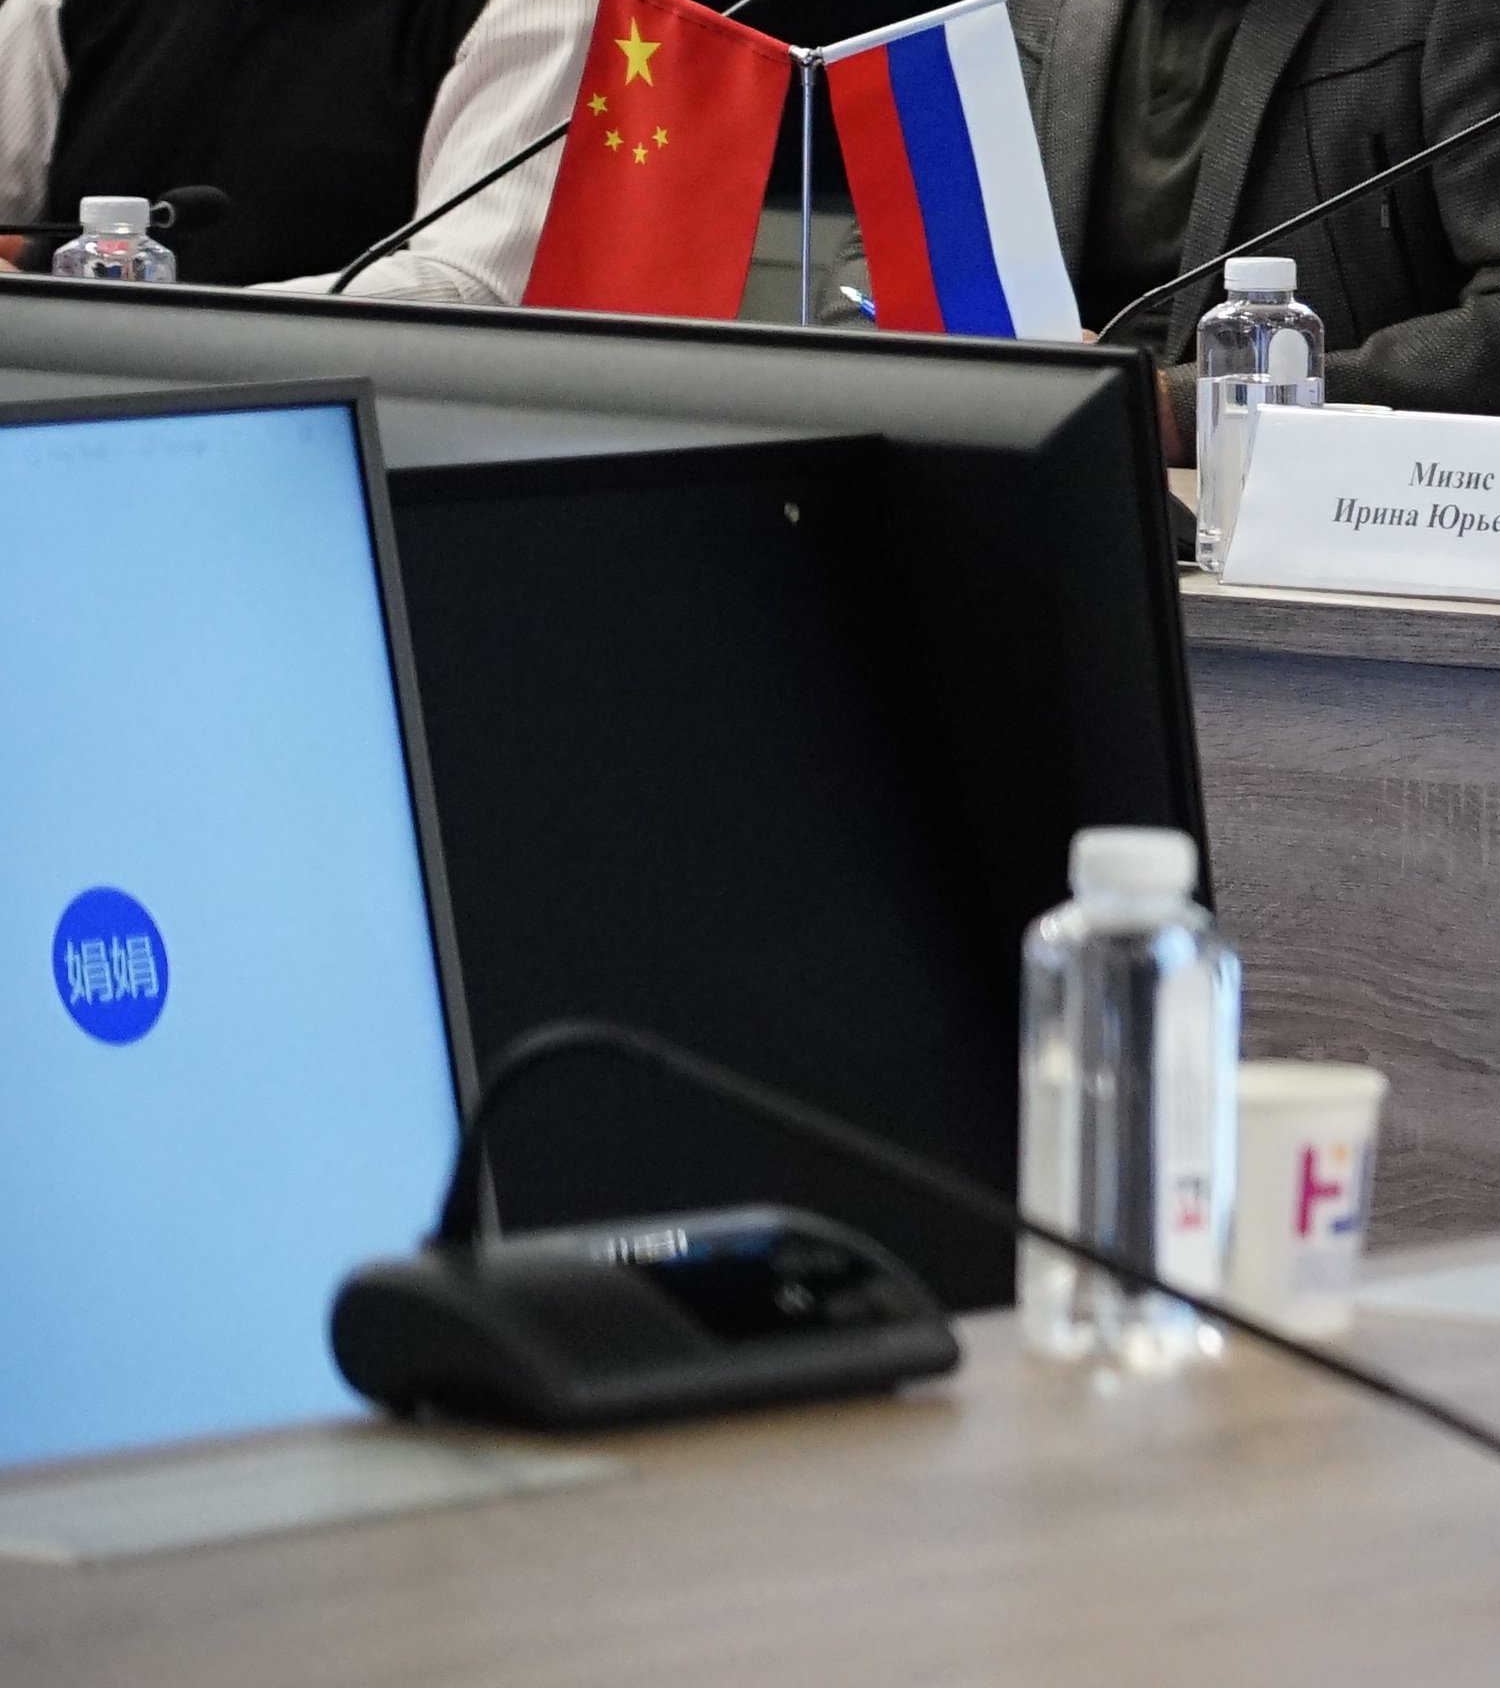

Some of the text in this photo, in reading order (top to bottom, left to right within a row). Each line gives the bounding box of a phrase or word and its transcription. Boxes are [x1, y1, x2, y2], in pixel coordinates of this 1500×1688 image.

[1408, 461, 1495, 491] Мизис
[1332, 497, 1418, 531] Ирина
[64, 931, 160, 1006] 娟娟
